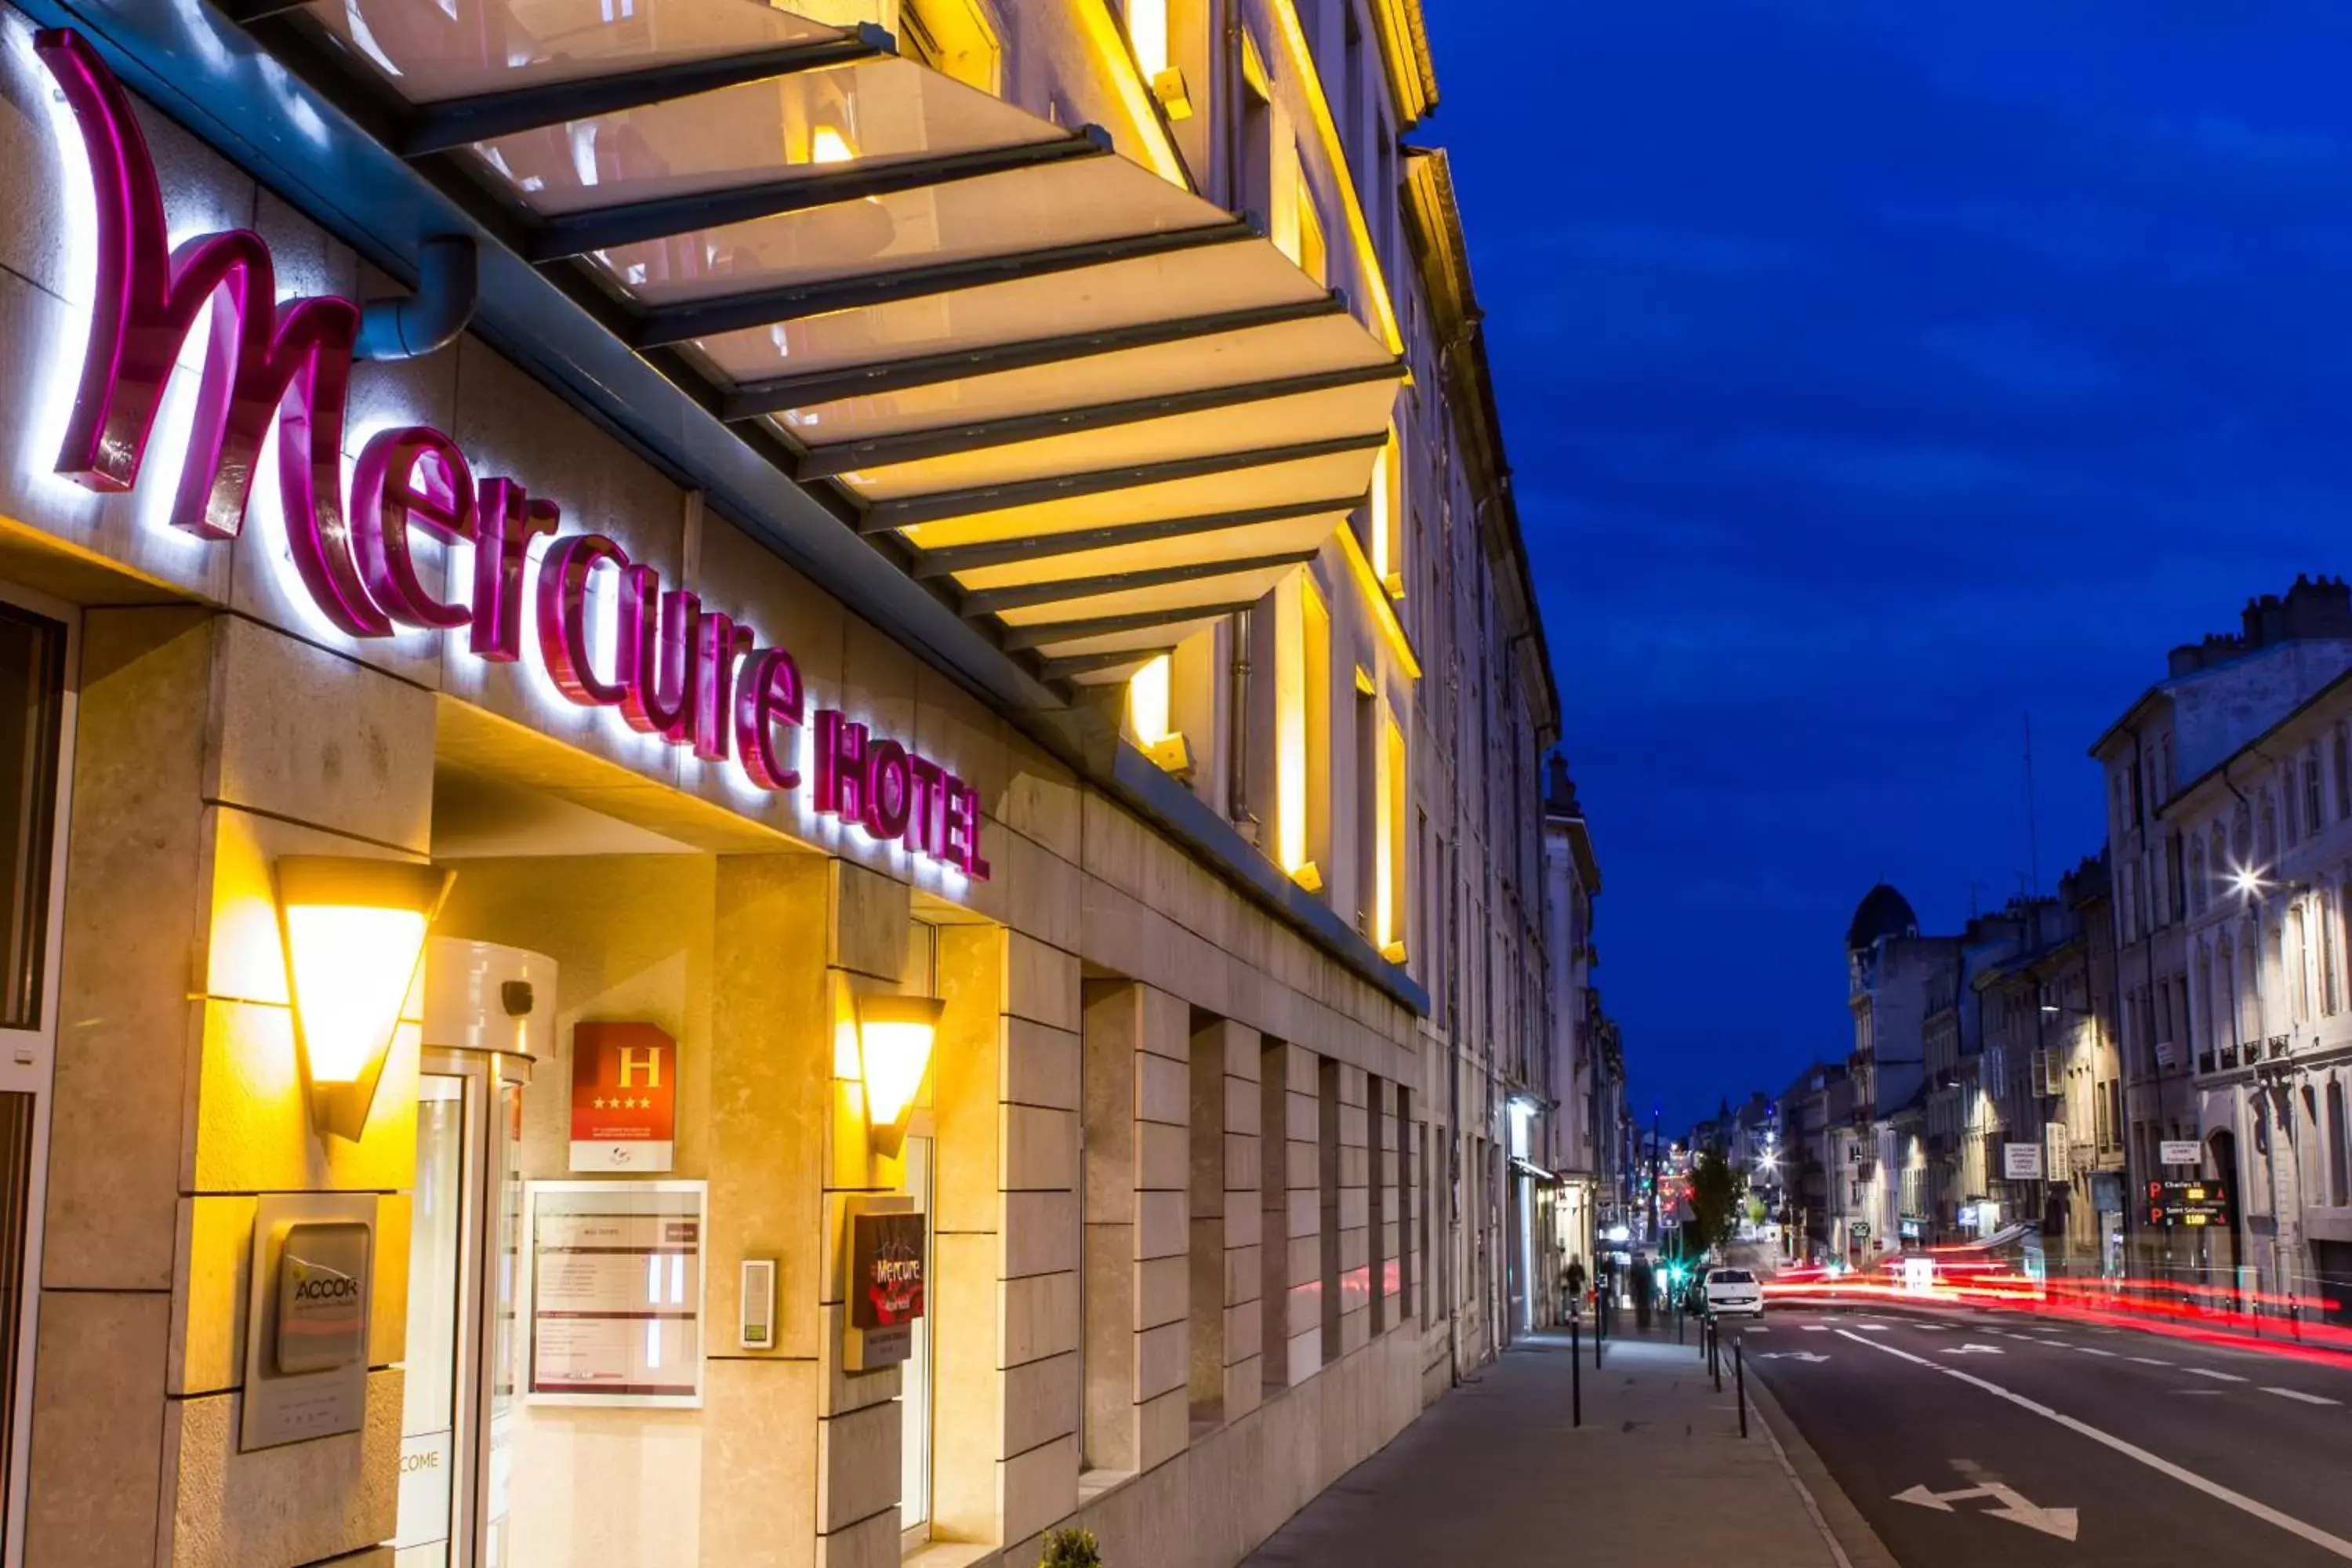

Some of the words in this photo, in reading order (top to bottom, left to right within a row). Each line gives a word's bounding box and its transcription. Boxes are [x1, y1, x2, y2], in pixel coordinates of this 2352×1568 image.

[34, 27, 804, 790] Mercure
[814, 710, 989, 880] HOTEL
[616, 1047, 666, 1087] H
[296, 1279, 358, 1301] ACCOR
